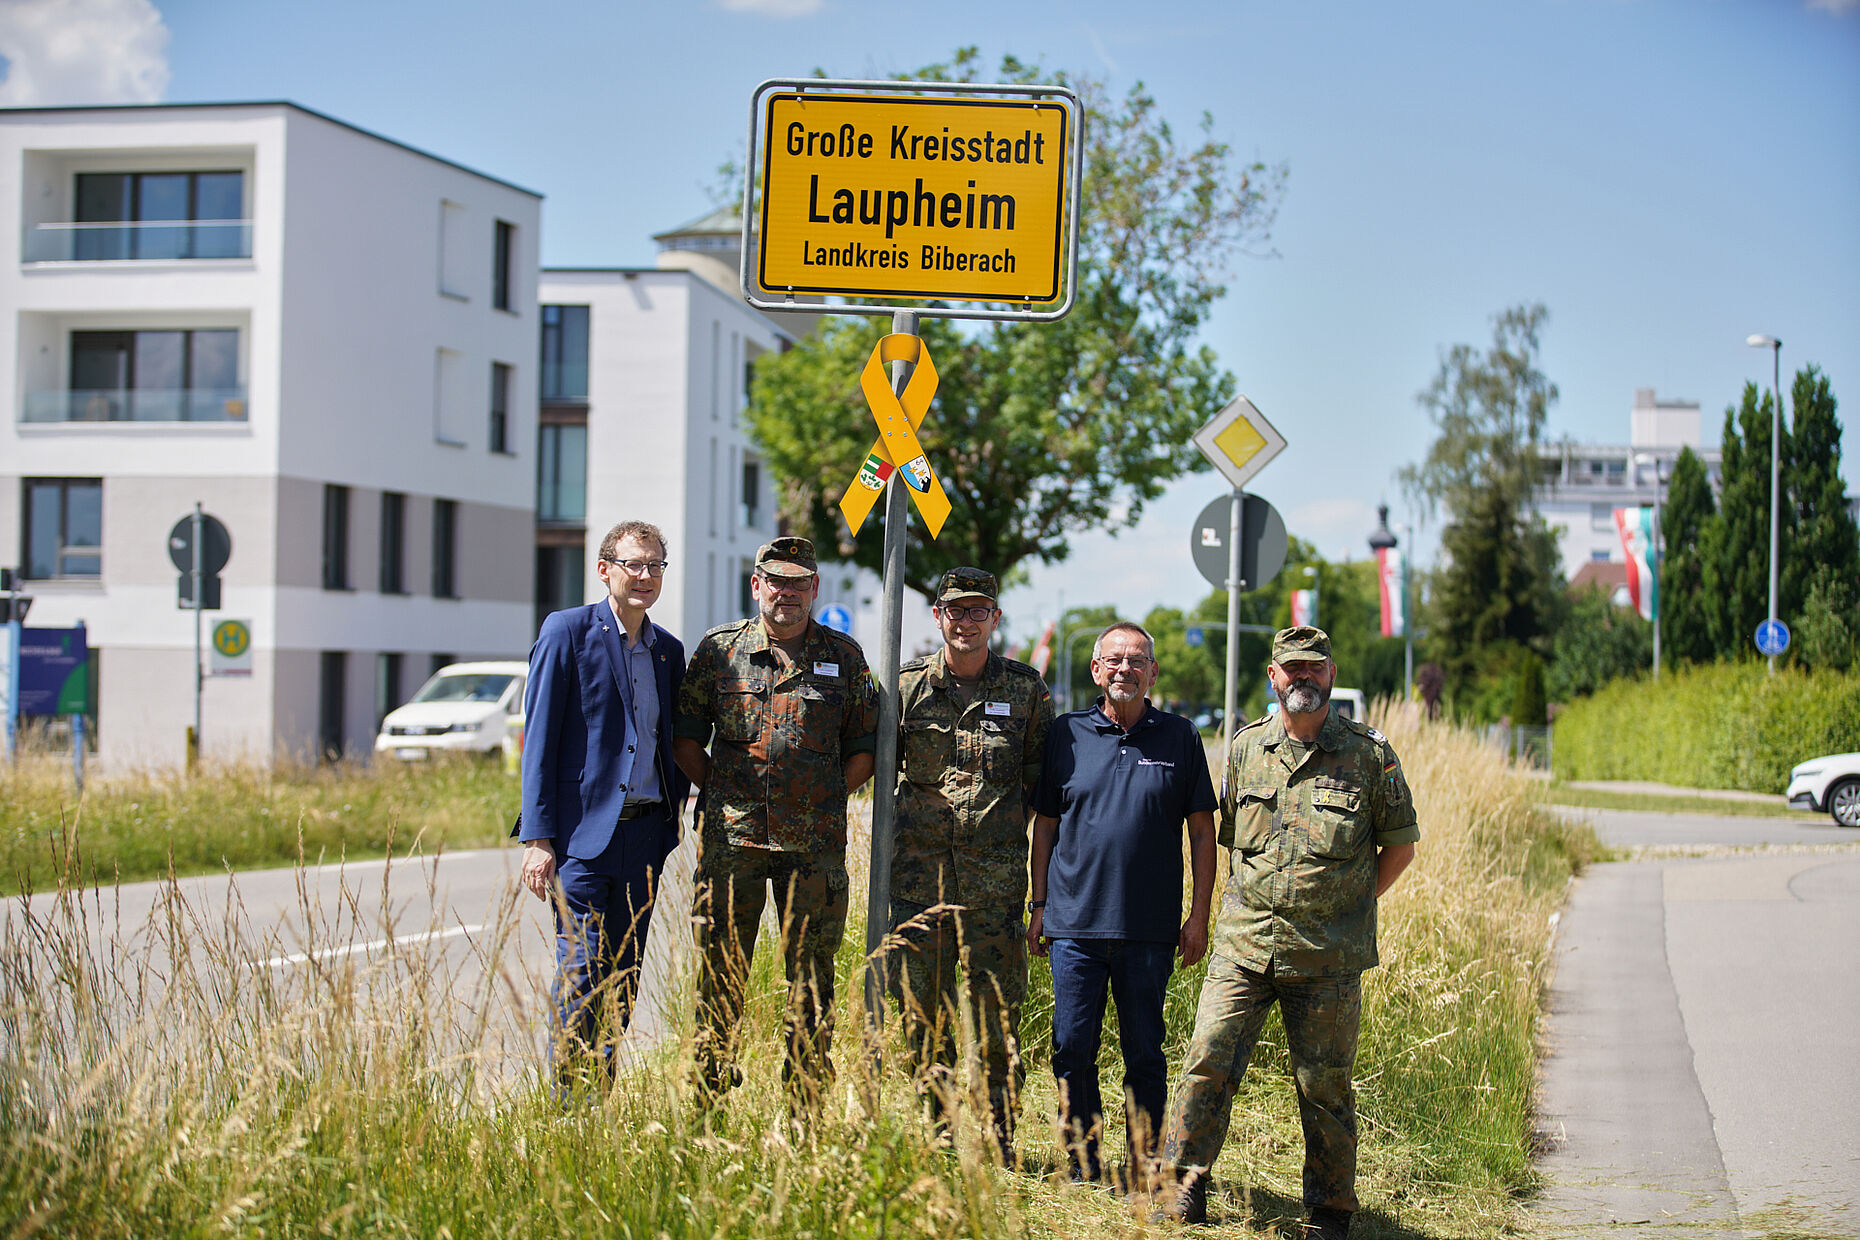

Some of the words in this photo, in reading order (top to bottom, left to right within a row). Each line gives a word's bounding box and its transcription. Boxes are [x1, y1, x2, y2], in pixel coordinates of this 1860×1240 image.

[787, 121, 873, 158] Große
[890, 125, 1044, 164] Kreisstadt
[808, 174, 1016, 238] Laupheim
[803, 240, 909, 268] Landkreis
[921, 244, 1016, 273] Biberach
